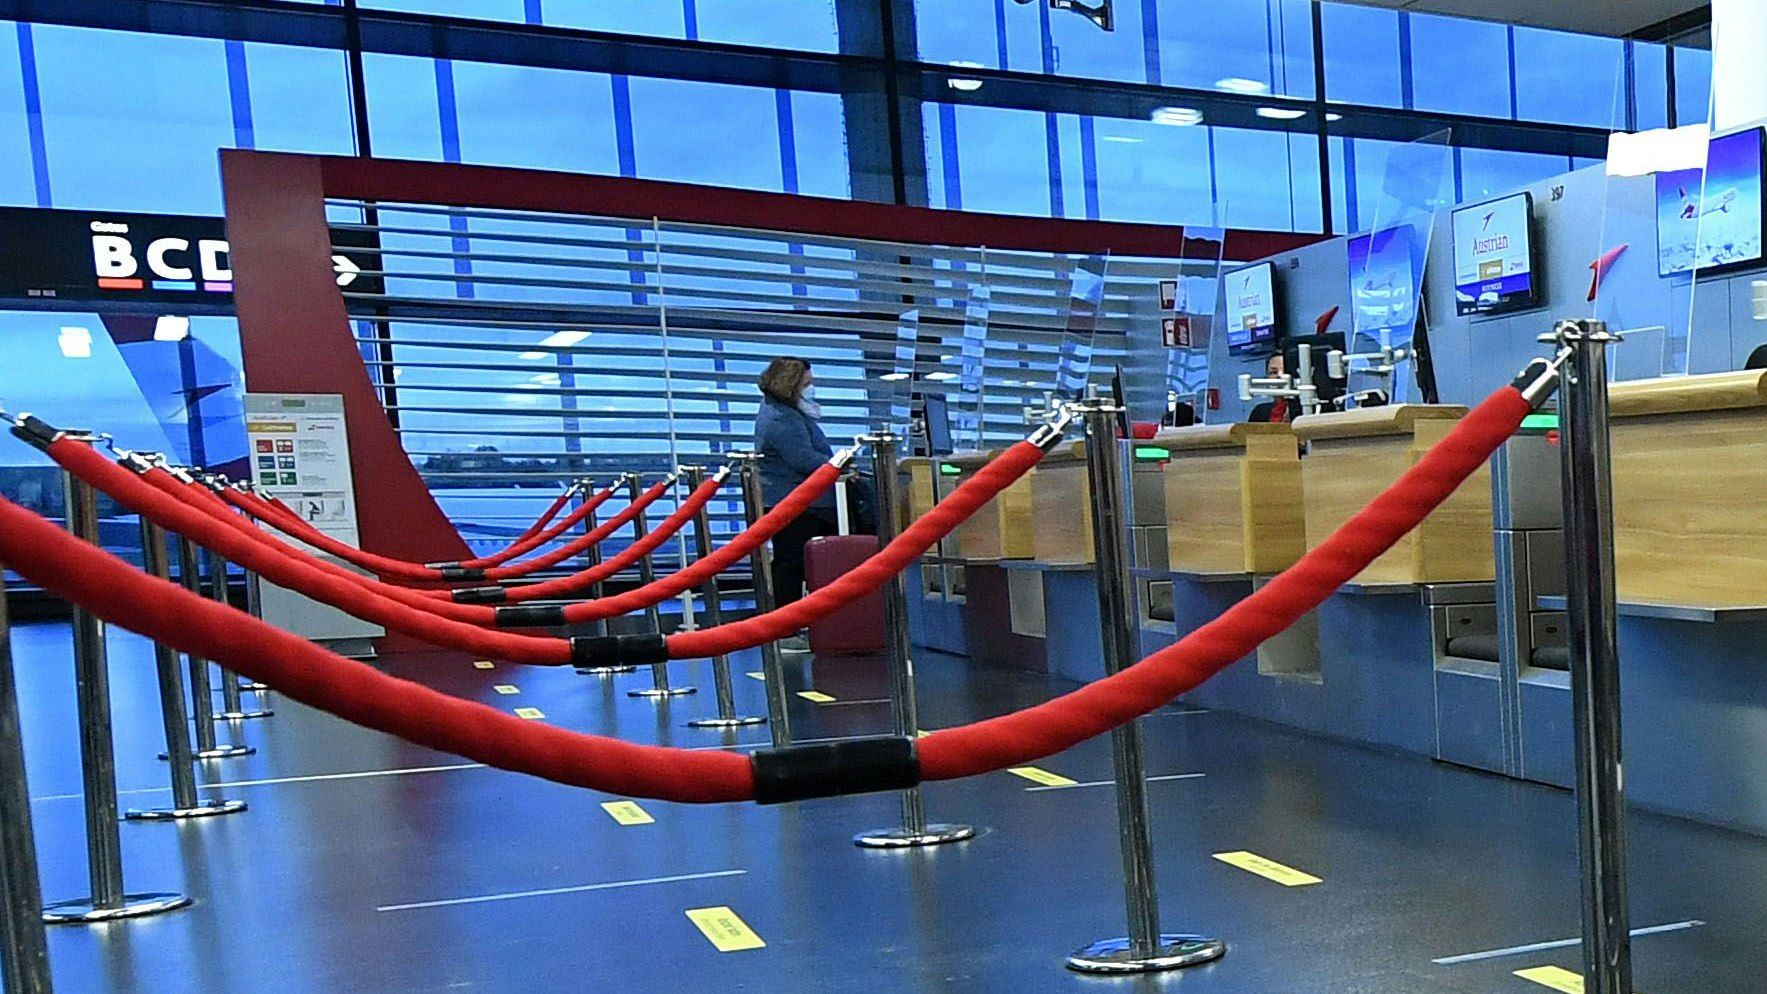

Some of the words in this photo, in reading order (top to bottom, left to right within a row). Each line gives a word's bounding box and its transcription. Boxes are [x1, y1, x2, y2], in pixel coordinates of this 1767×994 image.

[92, 235, 138, 278] B
[146, 237, 193, 280] C
[1472, 232, 1509, 257] Austrian
